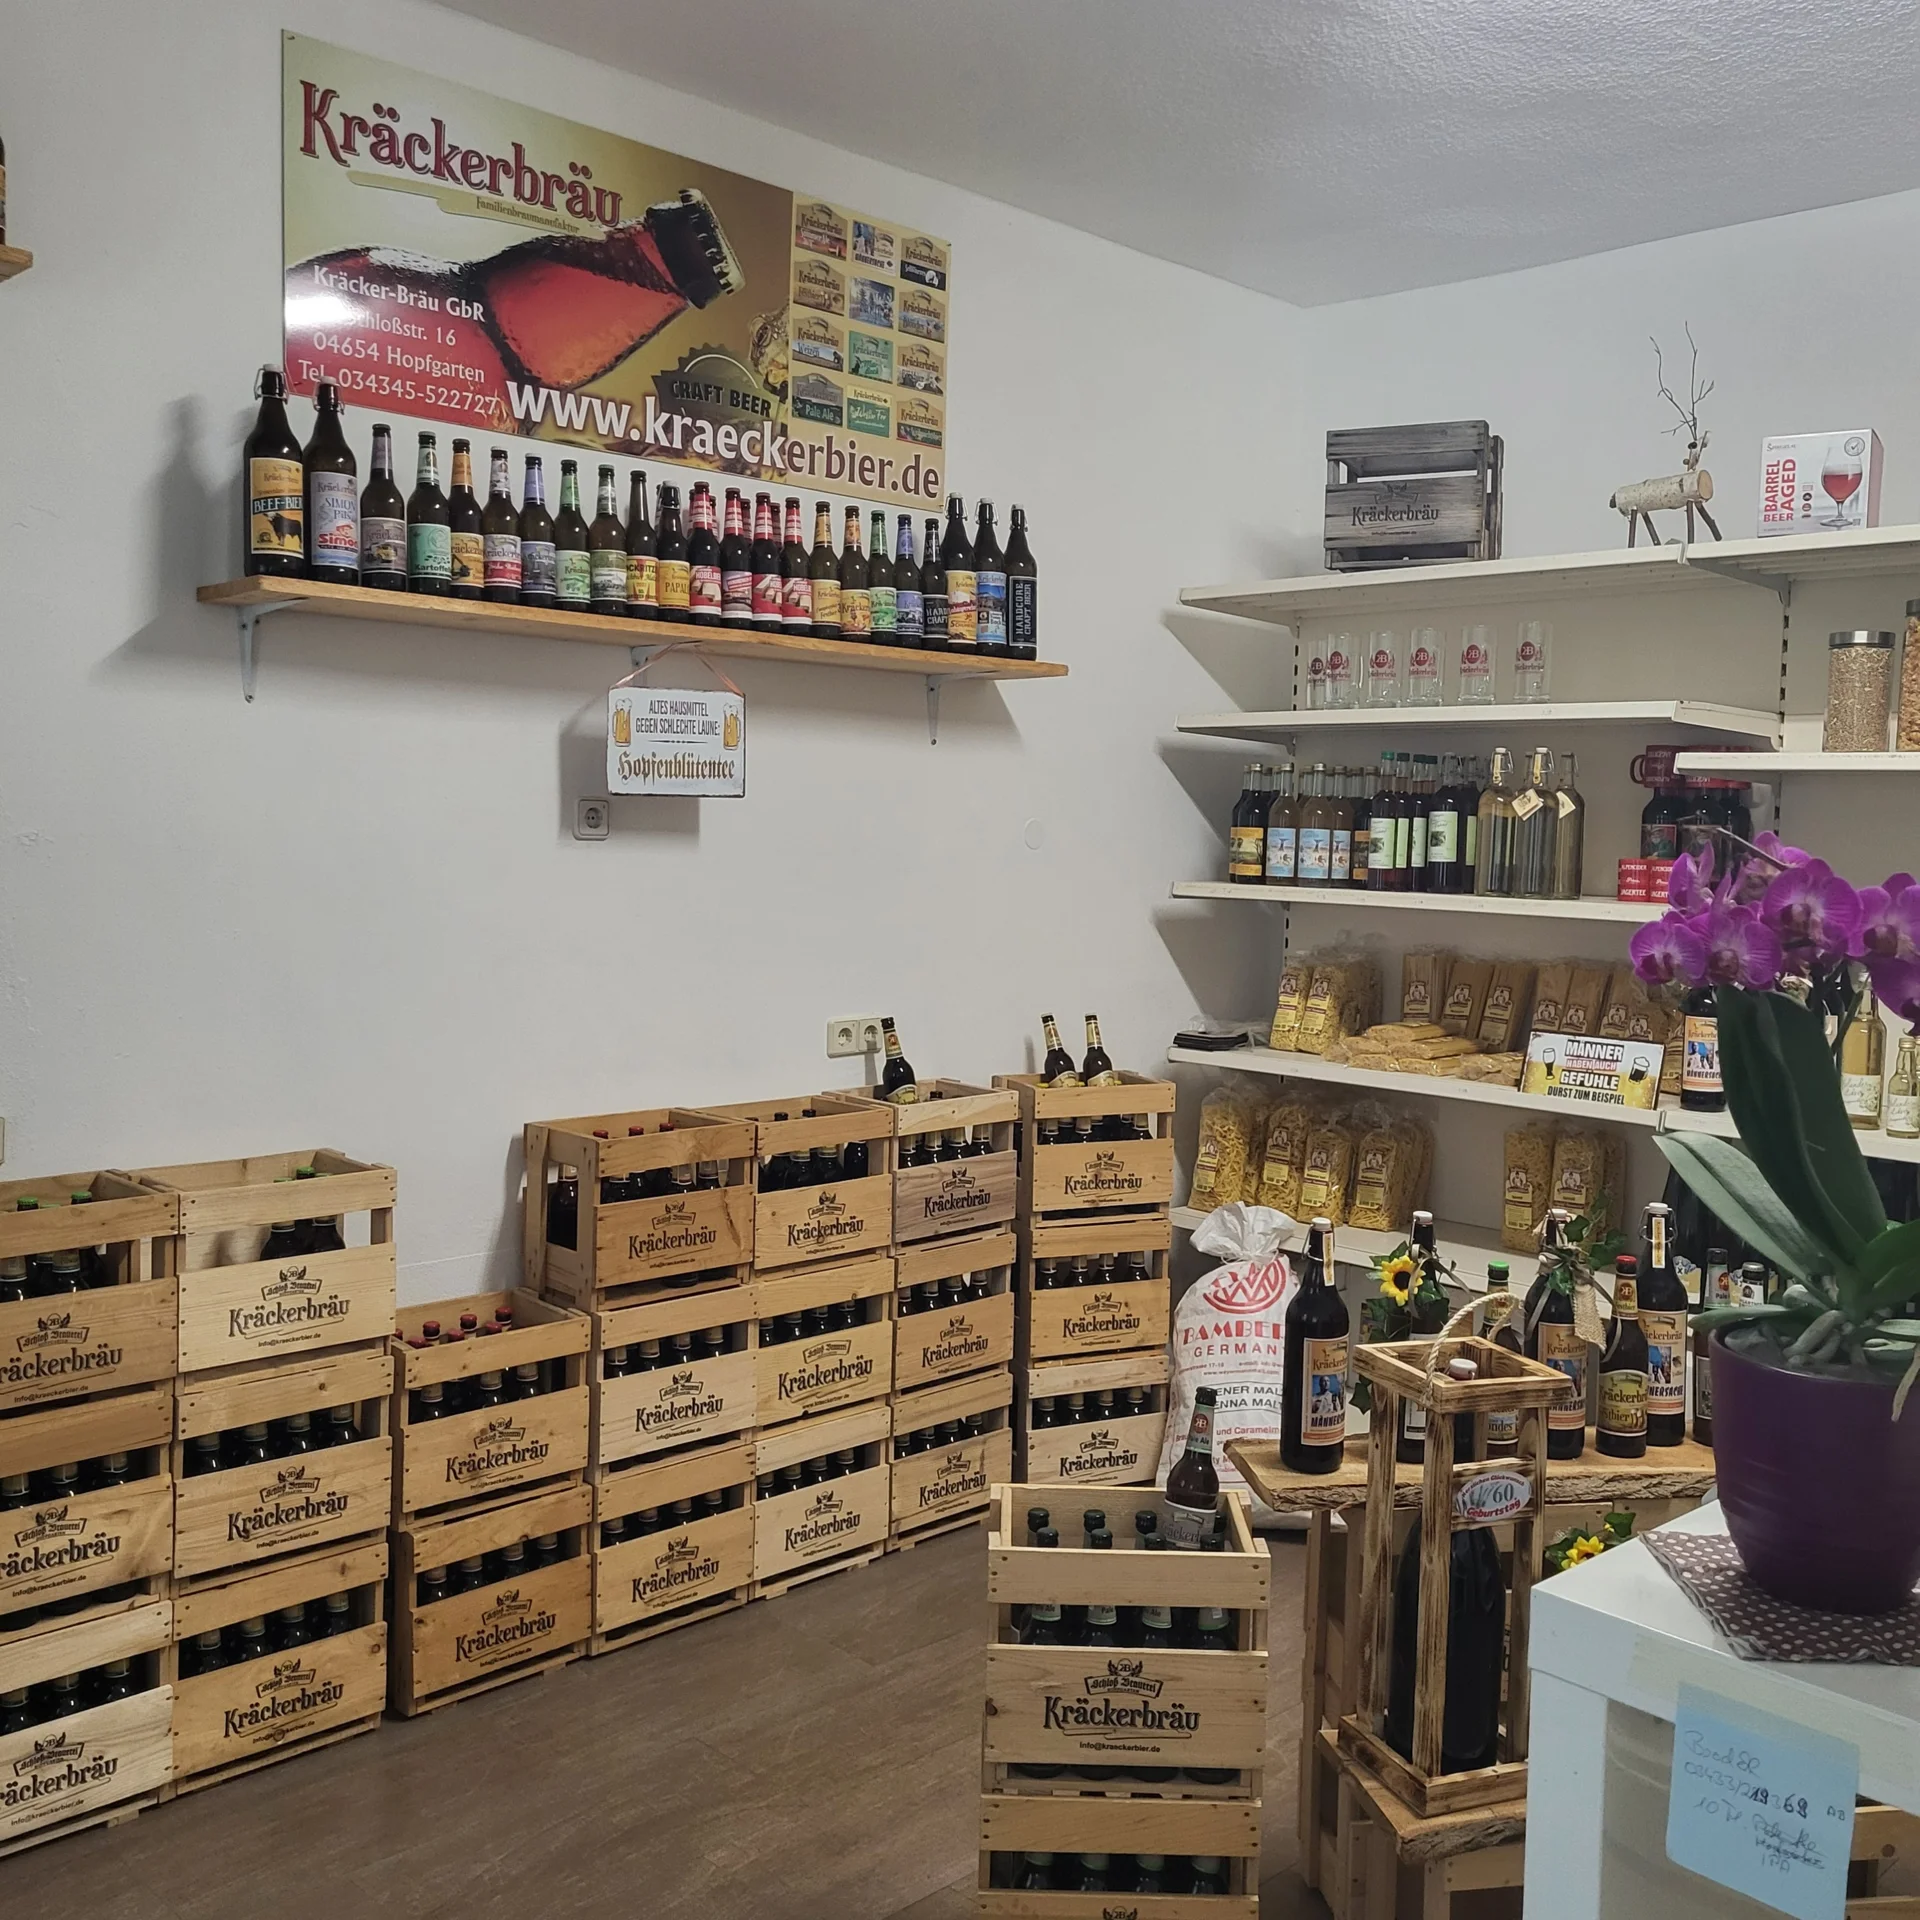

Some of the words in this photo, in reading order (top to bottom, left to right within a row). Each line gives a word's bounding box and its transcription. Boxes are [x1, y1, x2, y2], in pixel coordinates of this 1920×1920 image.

[299, 79, 623, 228] Kräckerbräu
[314, 265, 439, 312] Kräcker-Bräu
[446, 297, 486, 322] GbR
[437, 327, 456, 346] 16
[313, 332, 380, 361] 04654
[387, 346, 485, 383] Hopfgarten
[338, 368, 500, 416] 034345-522727
[671, 380, 724, 405] CRAFT
[729, 389, 772, 418] BEER
[805, 404, 821, 418] Pale
[822, 409, 834, 421] Ale
[506, 380, 940, 499] www.kraeckerbier.de
[1764, 459, 1780, 513] BARREL
[1780, 459, 1796, 511] AGED
[1351, 504, 1440, 526] Kräckerbräu
[1763, 513, 1794, 523] BEER
[1015, 583, 1024, 636] HARDCORE
[1024, 583, 1032, 606] BEER
[1024, 609, 1032, 636] CRAFT
[648, 700, 668, 715] ALTES
[669, 701, 709, 717] HAUSMITTEL
[635, 718, 658, 734] GEGEN
[659, 718, 697, 736] SCHLECHTE
[697, 719, 721, 736] LAUNE:
[1565, 1039, 1624, 1061] MÄNNER
[1566, 1058, 1593, 1069] HABEN
[1595, 1060, 1616, 1071] AUCH
[1547, 1085, 1573, 1098] DURST
[1573, 1088, 1591, 1100] ZUM
[1591, 1089, 1625, 1105] BEISPIEL
[1561, 1070, 1620, 1090] GEFÜHLE
[1064, 1173, 1142, 1195] Kräckerbräu
[924, 1189, 991, 1218] Kräckerbräu
[628, 1225, 717, 1259] Kräckerbräu
[787, 1215, 864, 1246] Kräckerbräu
[228, 1294, 351, 1338] Kräckerbräu
[1063, 1314, 1141, 1338] Kräckerbräu
[0, 1343, 123, 1384] räckerbräu
[922, 1335, 988, 1368] Kräckerbräu
[1194, 1343, 1277, 1358] GERMAN
[778, 1354, 873, 1400] Kräckerbräu
[1216, 1385, 1251, 1397] ENER
[1253, 1385, 1283, 1396] MAL
[635, 1394, 724, 1433] Kräckerbräu
[1214, 1398, 1249, 1410] ENNA
[1216, 1426, 1233, 1436] und
[1234, 1425, 1280, 1435] Caramelm
[445, 1439, 549, 1483] Kräckerbräu
[1059, 1449, 1138, 1477] Kräckerbräu
[919, 1472, 987, 1507] Kräckerbräu
[227, 1491, 349, 1541] Kräckerbräu
[1466, 1499, 1521, 1518] Geburtstag
[784, 1511, 860, 1552] Kräckerbräu
[0, 1532, 122, 1580] räckerbräu
[631, 1557, 720, 1603] Kräckerbräu
[455, 1611, 557, 1662] Kräckerbräu
[224, 1681, 344, 1738] Kräckerbräu
[1043, 1696, 1201, 1732] Kräckerbräu
[0, 1755, 119, 1807] äckerbräu
